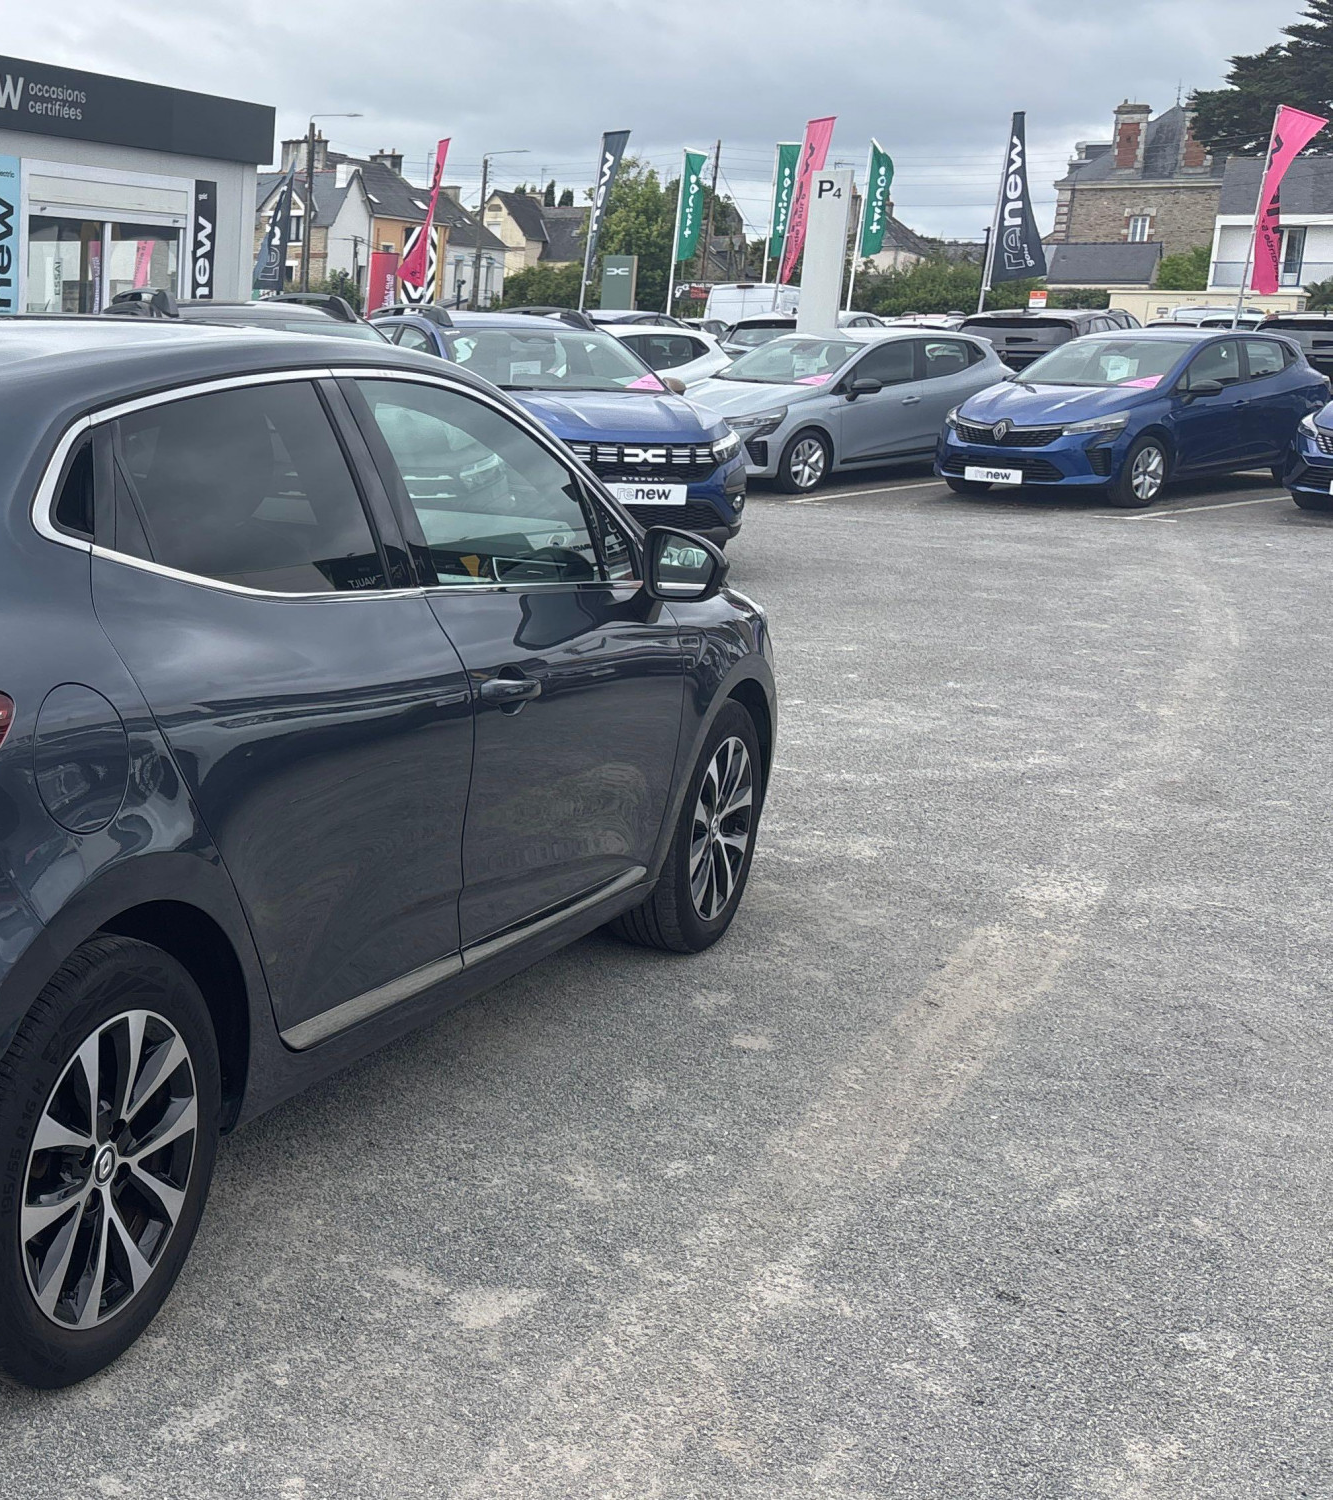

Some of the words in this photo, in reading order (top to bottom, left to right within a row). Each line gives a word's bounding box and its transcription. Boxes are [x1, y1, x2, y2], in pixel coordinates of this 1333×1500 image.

[28, 82, 87, 104] occasions
[28, 100, 83, 121] certifiées
[817, 179, 842, 200] P4
[1003, 135, 1026, 270] renew
[54, 261, 63, 296] ESSAI
[974, 469, 1012, 481] renew
[616, 487, 672, 501] renew
[0, 1146, 22, 1219] 195/55
